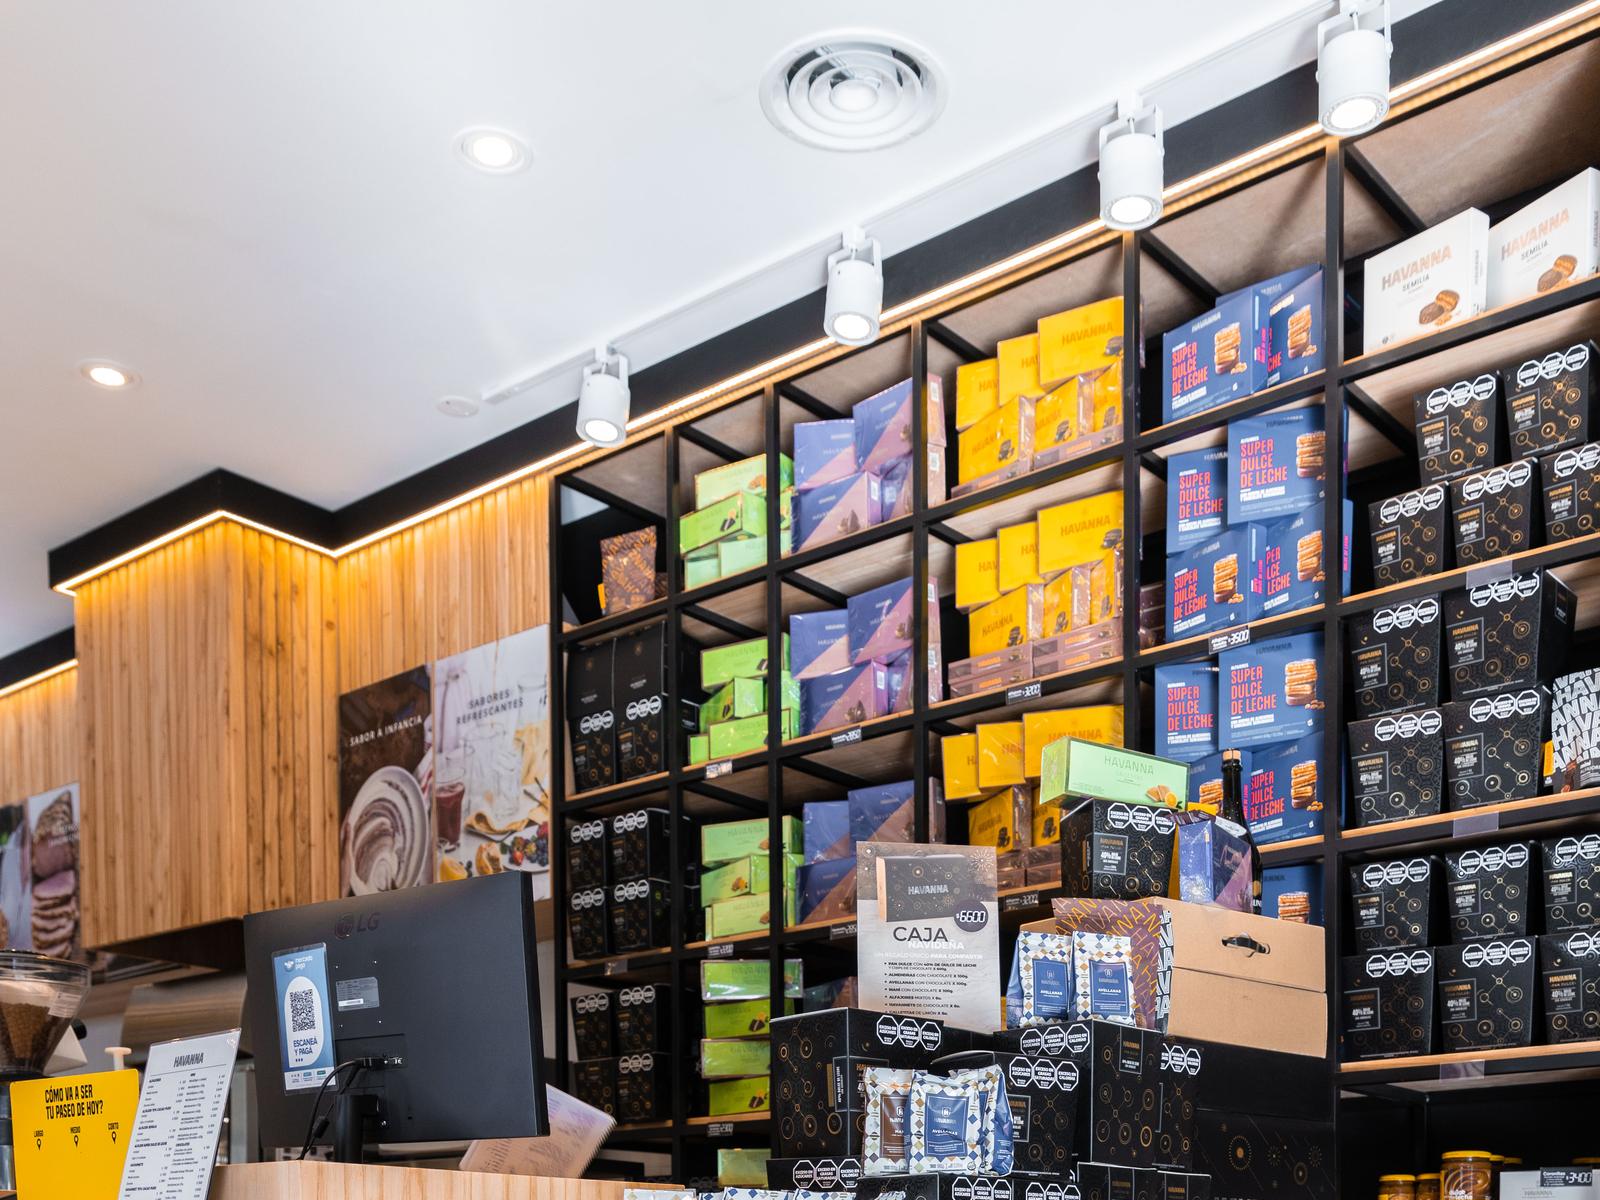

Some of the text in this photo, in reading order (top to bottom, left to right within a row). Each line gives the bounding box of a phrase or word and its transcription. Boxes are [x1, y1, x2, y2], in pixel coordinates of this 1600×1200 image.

[1501, 208, 1570, 262] HAVANNA
[1381, 245, 1453, 291] HAVANNA
[1062, 321, 1114, 345] HAVANNA
[1172, 342, 1197, 365] SUPER
[1267, 351, 1282, 372] CHE
[1172, 356, 1197, 380] DULCE
[1172, 365, 1208, 396] DE LECHE
[1240, 438, 1274, 458] SUPER
[1240, 453, 1273, 472] DULCE
[1179, 470, 1210, 491] SUPER
[1240, 466, 1288, 489] DE LECHE
[1179, 486, 1210, 505] DULCE
[1179, 497, 1224, 520] DE LECHE
[1060, 515, 1110, 536] HAVANNA
[1266, 546, 1281, 564] PER
[1174, 568, 1198, 590] SUPER
[1266, 562, 1281, 580] LCE
[1267, 572, 1291, 596] LECHE
[1174, 583, 1197, 606] DULCE
[1174, 594, 1207, 621] DE LECHE
[1452, 623, 1479, 636] HAVANNA
[1358, 650, 1383, 661] HAVANNA
[1230, 666, 1263, 684] SUPER
[469, 688, 511, 710] SABORES
[1167, 686, 1200, 701] SUPER
[1230, 682, 1263, 700] DULCE
[456, 698, 524, 725] REFRESCANTES
[1167, 700, 1199, 718] DULCE
[1230, 694, 1277, 716] DE LECHE
[349, 714, 423, 747] SABOR A INFANCIA
[1167, 717, 1180, 732] DE
[1182, 713, 1214, 730] LECHE
[1103, 755, 1155, 776] HAVANNA
[1357, 757, 1384, 768] HAVANNA
[1258, 798, 1285, 818] LECHE
[907, 884, 949, 896] HAVANNA
[357, 912, 380, 933] LG
[893, 926, 949, 943] CAJA
[907, 939, 965, 950] NAVIDEÑA
[1549, 974, 1577, 984] HAVANNA
[1040, 988, 1063, 996] AVELLANAS
[293, 1036, 318, 1048] ESCANEÁ
[299, 1046, 313, 1055] PAGÁ
[173, 1052, 205, 1068] HAVANNA
[45, 1084, 93, 1104] CÓMO VA A SER
[45, 1099, 104, 1120] TU PASEO DE HOY?
[932, 1128, 958, 1137] AVELLANAS
